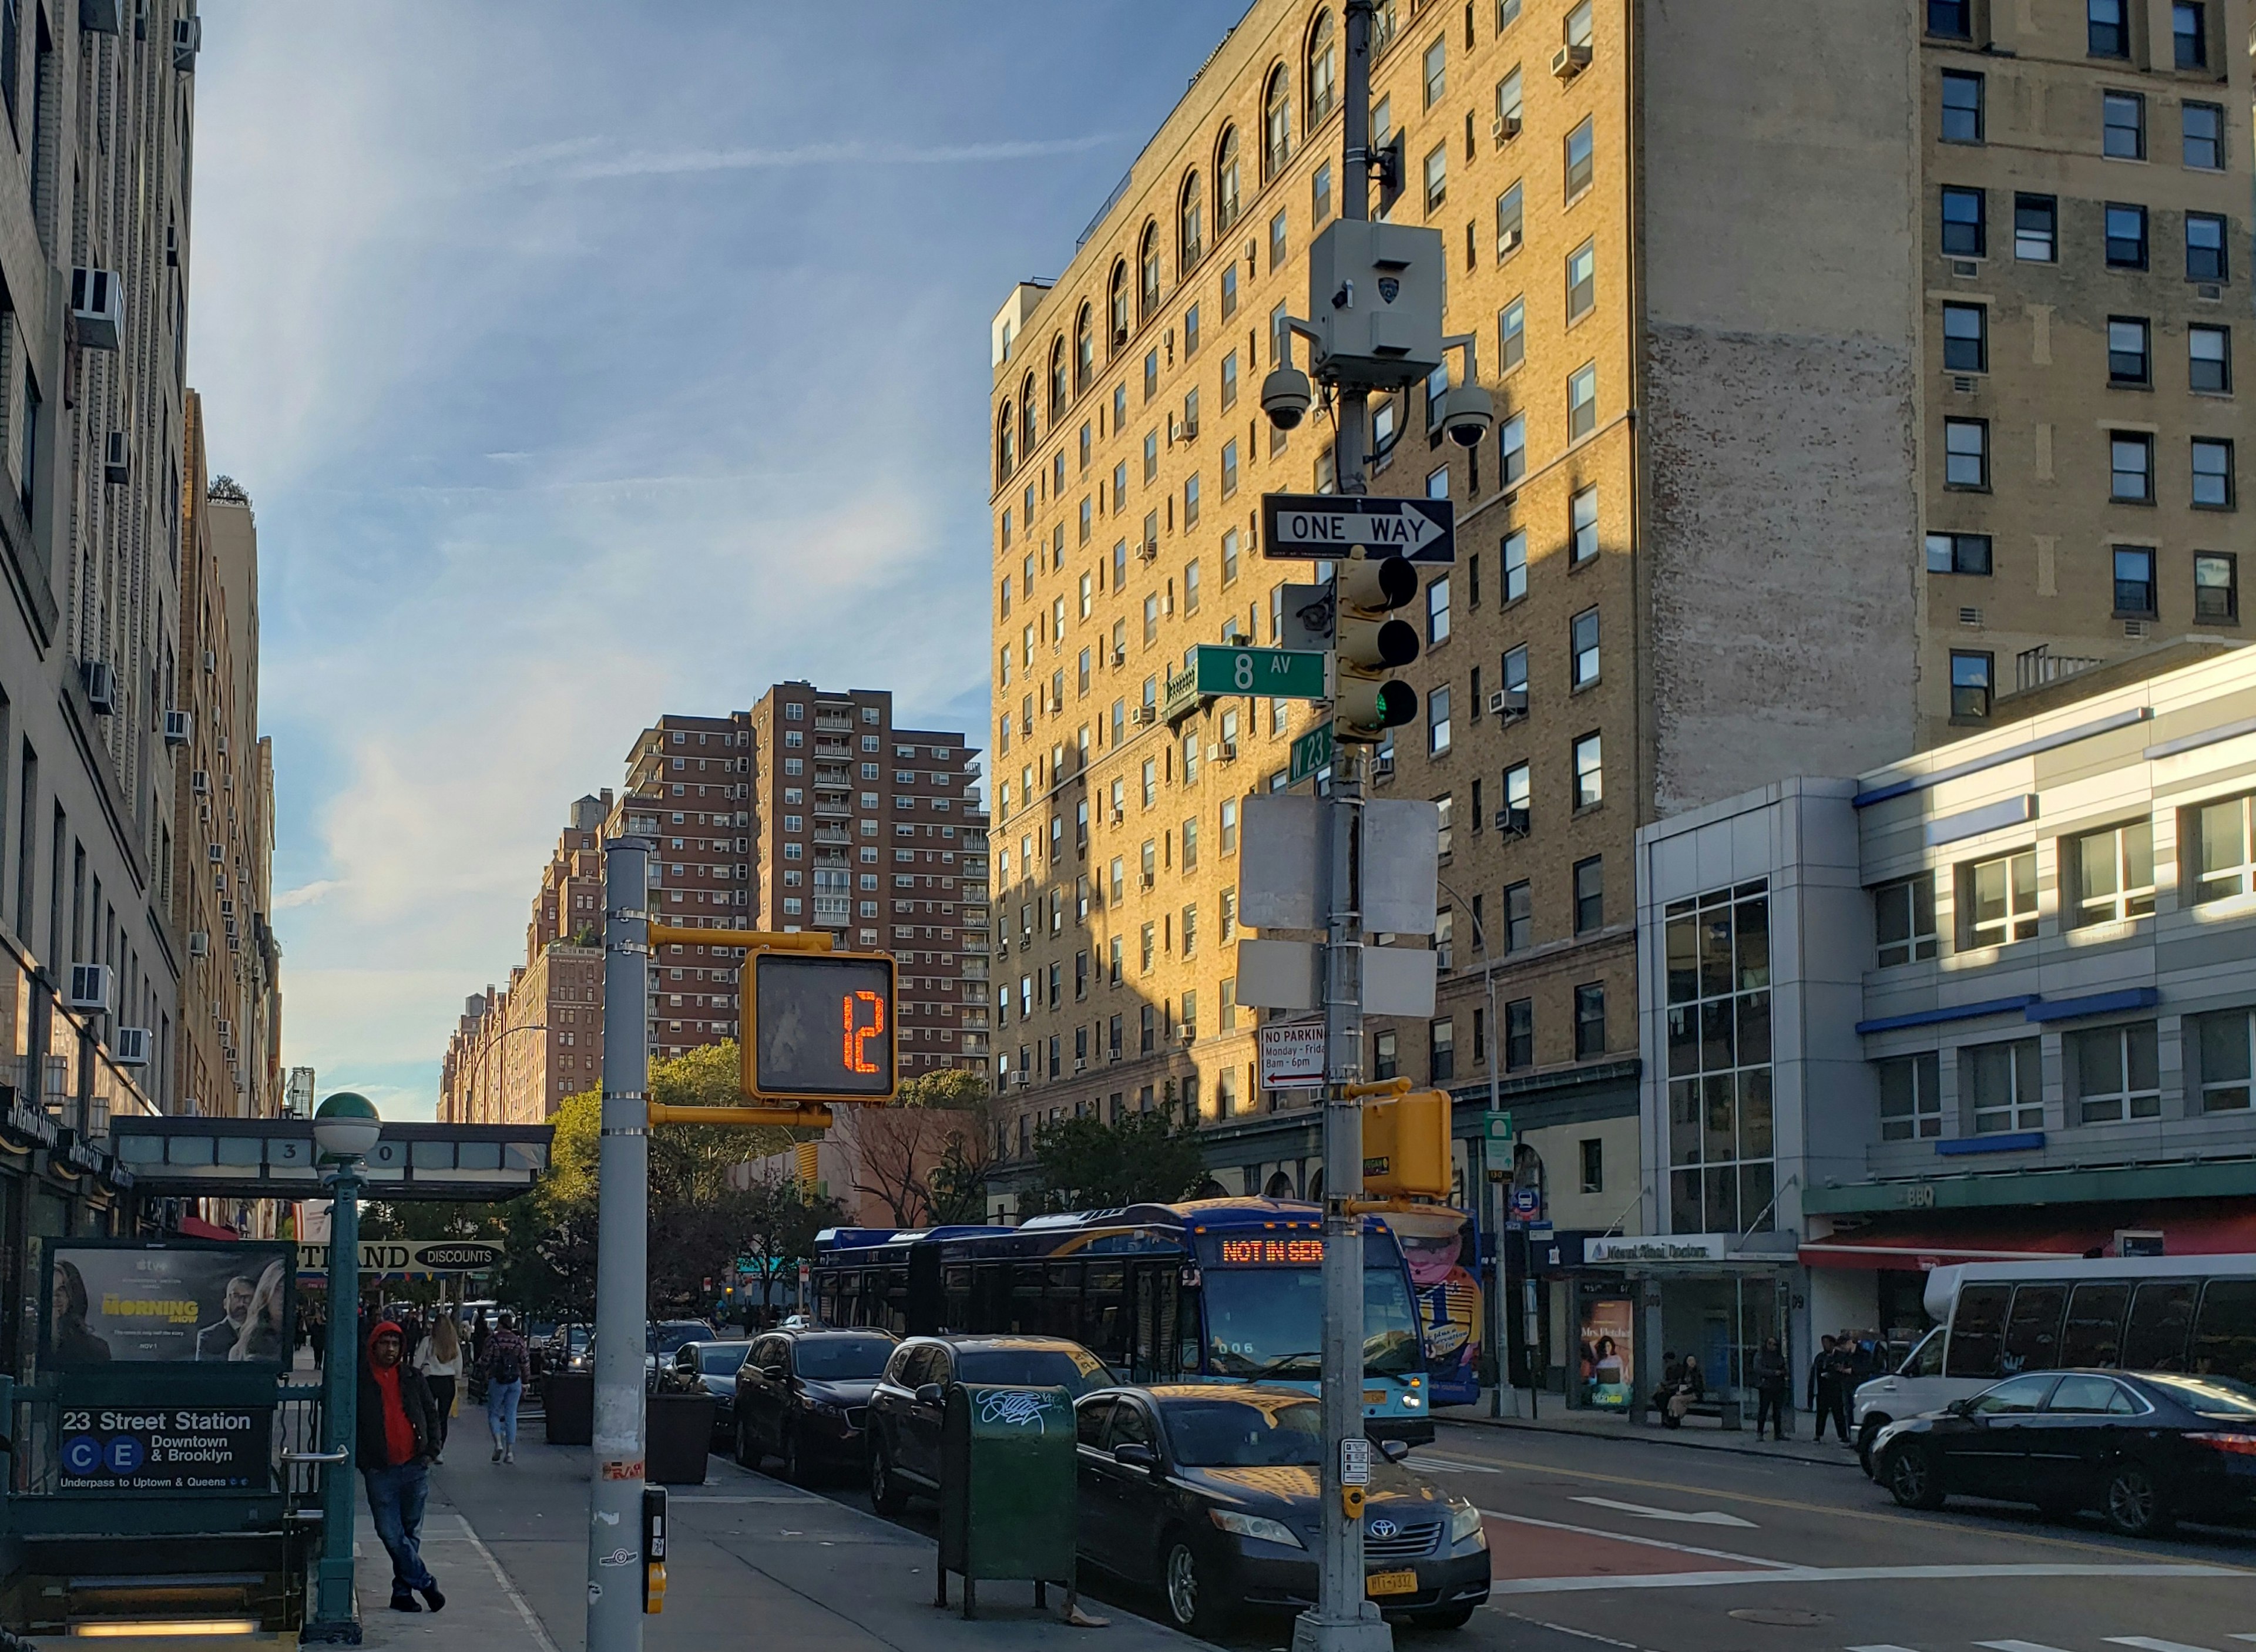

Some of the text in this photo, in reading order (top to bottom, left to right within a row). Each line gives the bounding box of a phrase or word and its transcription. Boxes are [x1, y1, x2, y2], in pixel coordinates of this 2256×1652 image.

[1292, 515, 1425, 542] ONE WAY
[1234, 653, 1291, 689] 8 AV
[1292, 742, 1302, 778] W
[1308, 731, 1322, 771] 23
[844, 990, 884, 1073] 12
[1266, 1029, 1326, 1043] NO PARKIN
[1265, 1046, 1297, 1056] Monday
[1305, 1044, 1325, 1054] Frida
[1266, 1059, 1284, 1068] 8am
[1292, 1057, 1310, 1069] 6pm
[1909, 1185, 1933, 1207] BBQ
[428, 1250, 492, 1263] DISCOUNTS
[1223, 1240, 1324, 1261] NOT IN SER
[102, 1300, 199, 1316] MORNING
[63, 1412, 250, 1430] 23 Street Station
[151, 1435, 227, 1448] Downtown
[72, 1444, 132, 1466] C E
[151, 1449, 232, 1463] & Brooklyn
[61, 1478, 115, 1488] Underpass
[119, 1478, 129, 1487] to
[133, 1477, 171, 1488] Uptown
[176, 1478, 183, 1487] &
[187, 1477, 226, 1487] Queens
